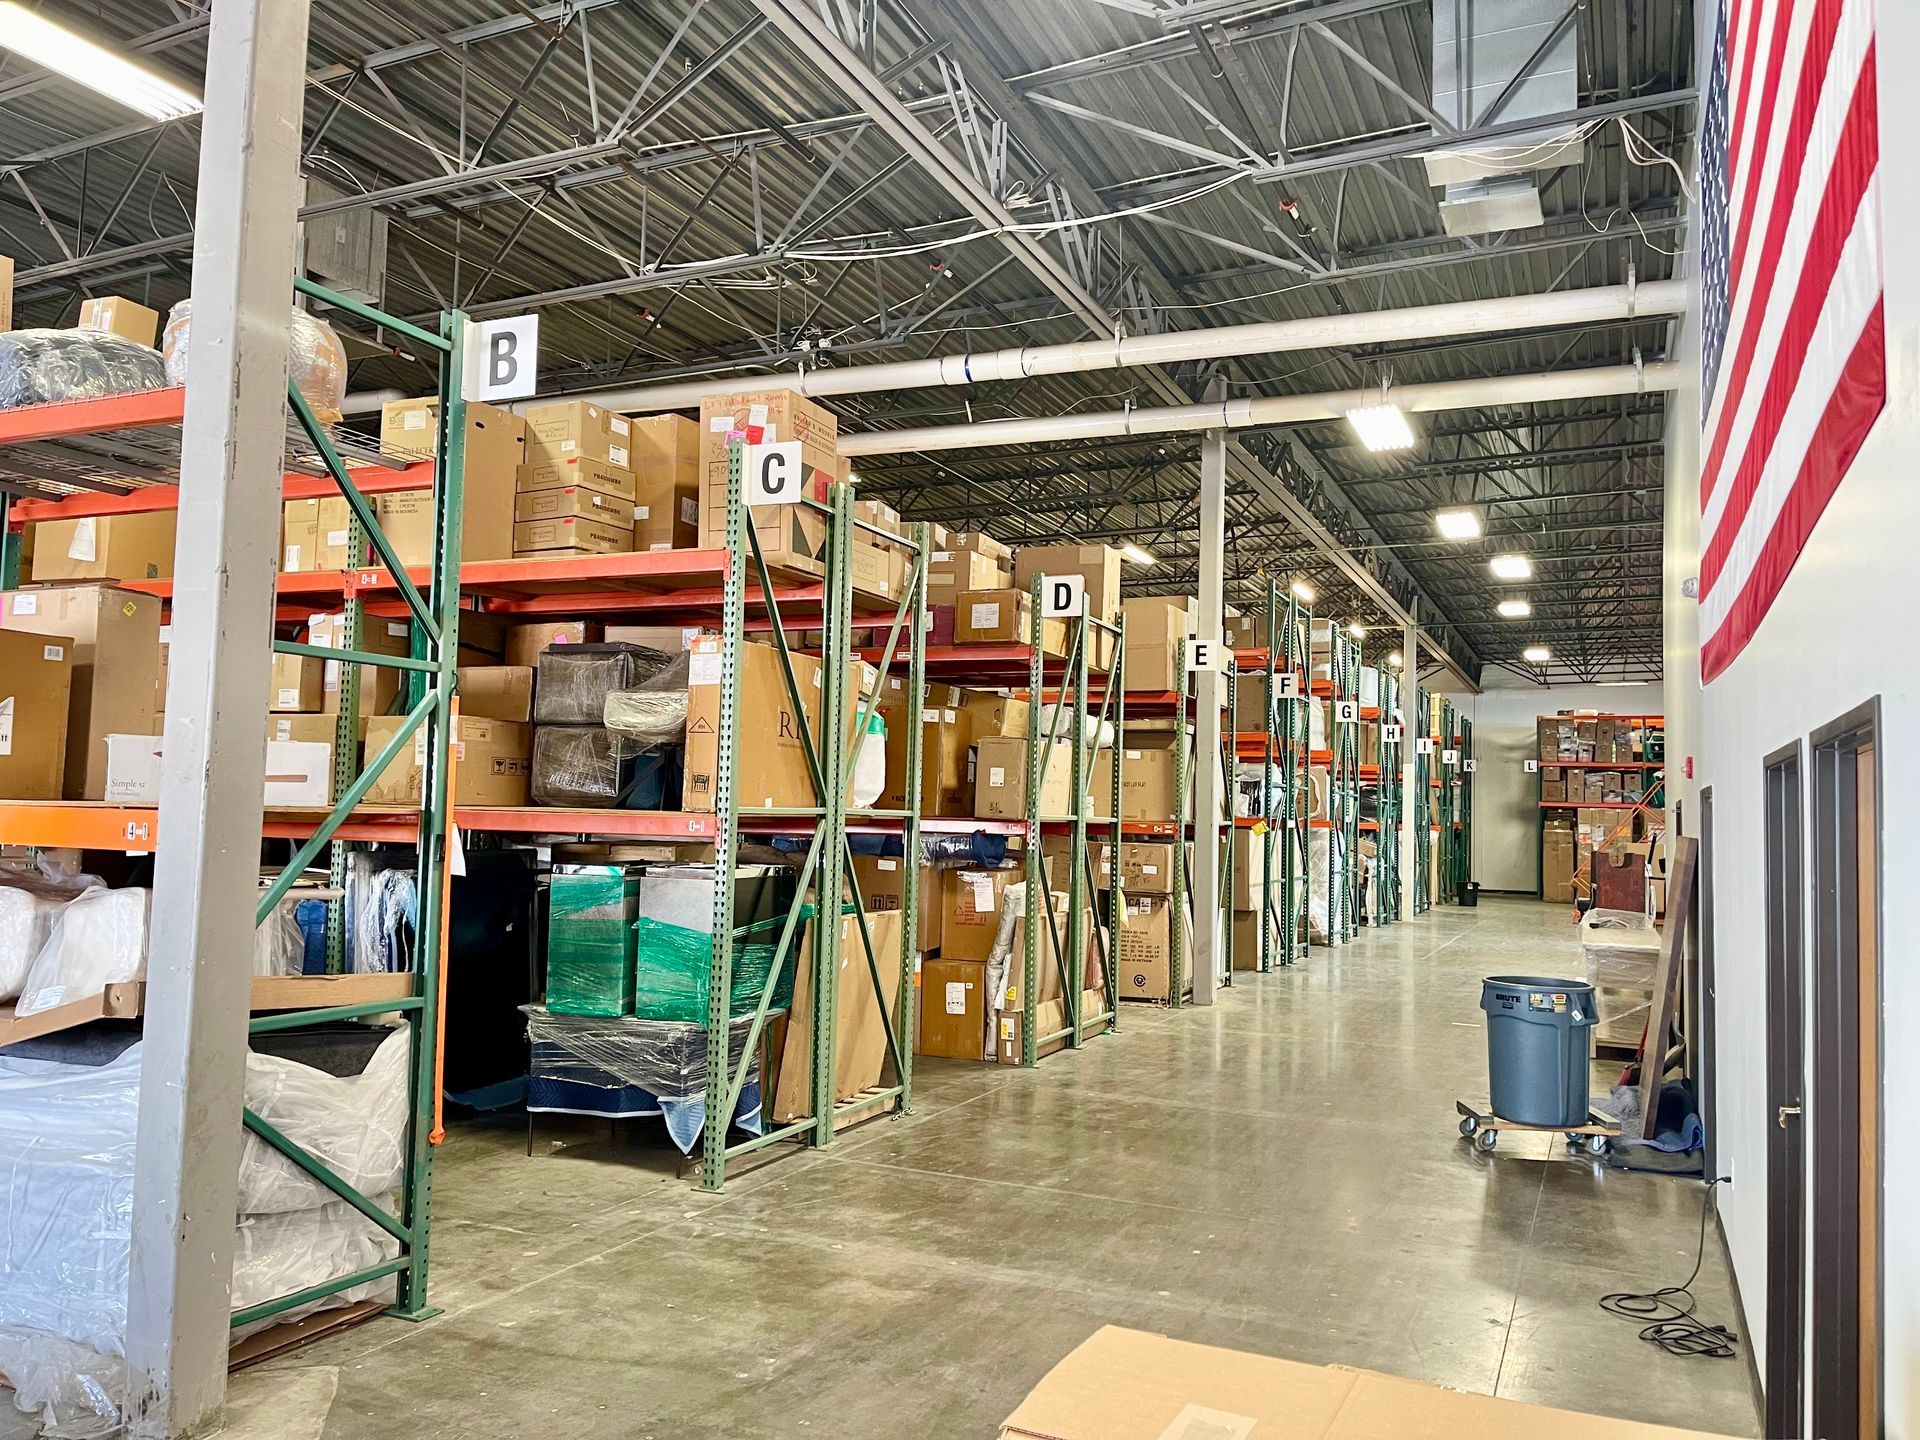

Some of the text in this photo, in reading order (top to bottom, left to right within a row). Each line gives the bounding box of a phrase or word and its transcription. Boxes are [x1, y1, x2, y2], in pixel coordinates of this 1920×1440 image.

[489, 331, 518, 387] B
[761, 452, 786, 495] C
[1053, 582, 1072, 611] D
[1195, 644, 1208, 666] E
[1280, 677, 1291, 694] F
[1341, 704, 1352, 719] G
[1387, 728, 1395, 739] H
[1423, 741, 1427, 752] I
[1447, 752, 1453, 762] J
[1466, 761, 1473, 770] K
[1528, 762, 1533, 771] L
[111, 779, 137, 791] Simple
[1495, 993, 1521, 1003] BRUTE
